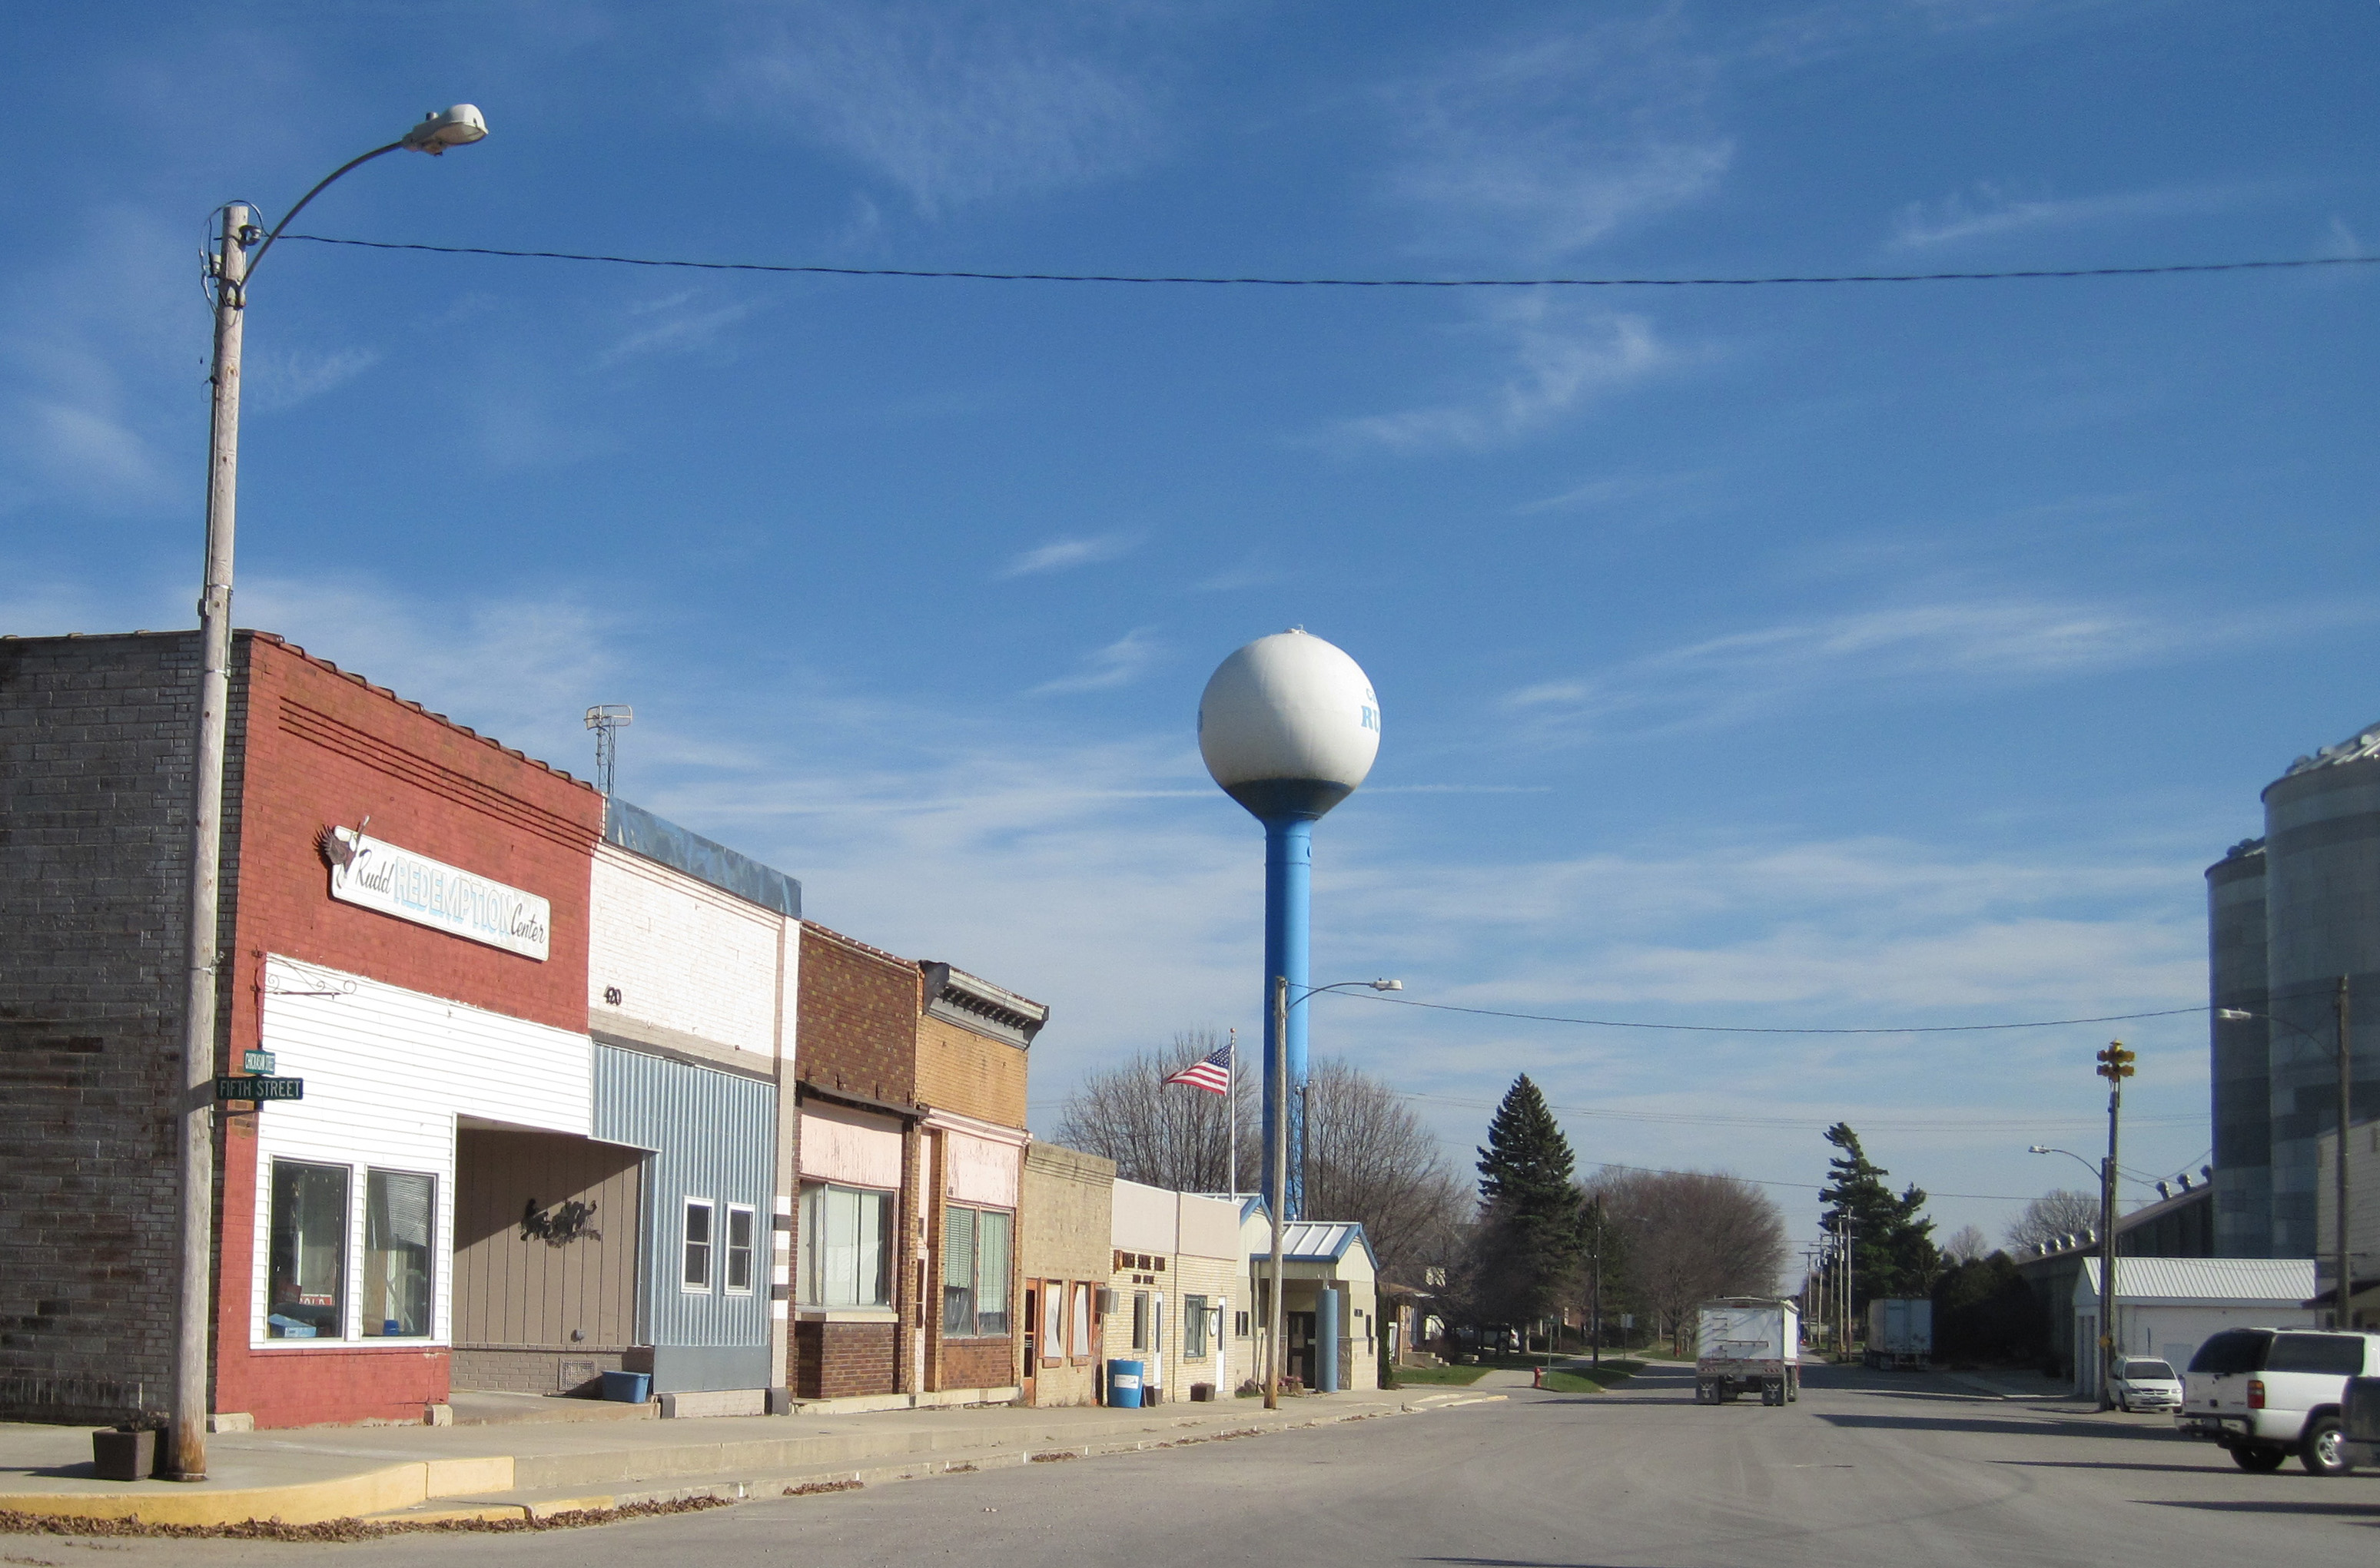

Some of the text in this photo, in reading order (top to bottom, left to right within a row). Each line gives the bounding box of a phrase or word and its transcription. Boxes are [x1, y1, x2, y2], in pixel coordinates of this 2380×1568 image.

[356, 849, 545, 943] Rudd REDEMPTION Center
[220, 1080, 300, 1097] FIFTH STREET
